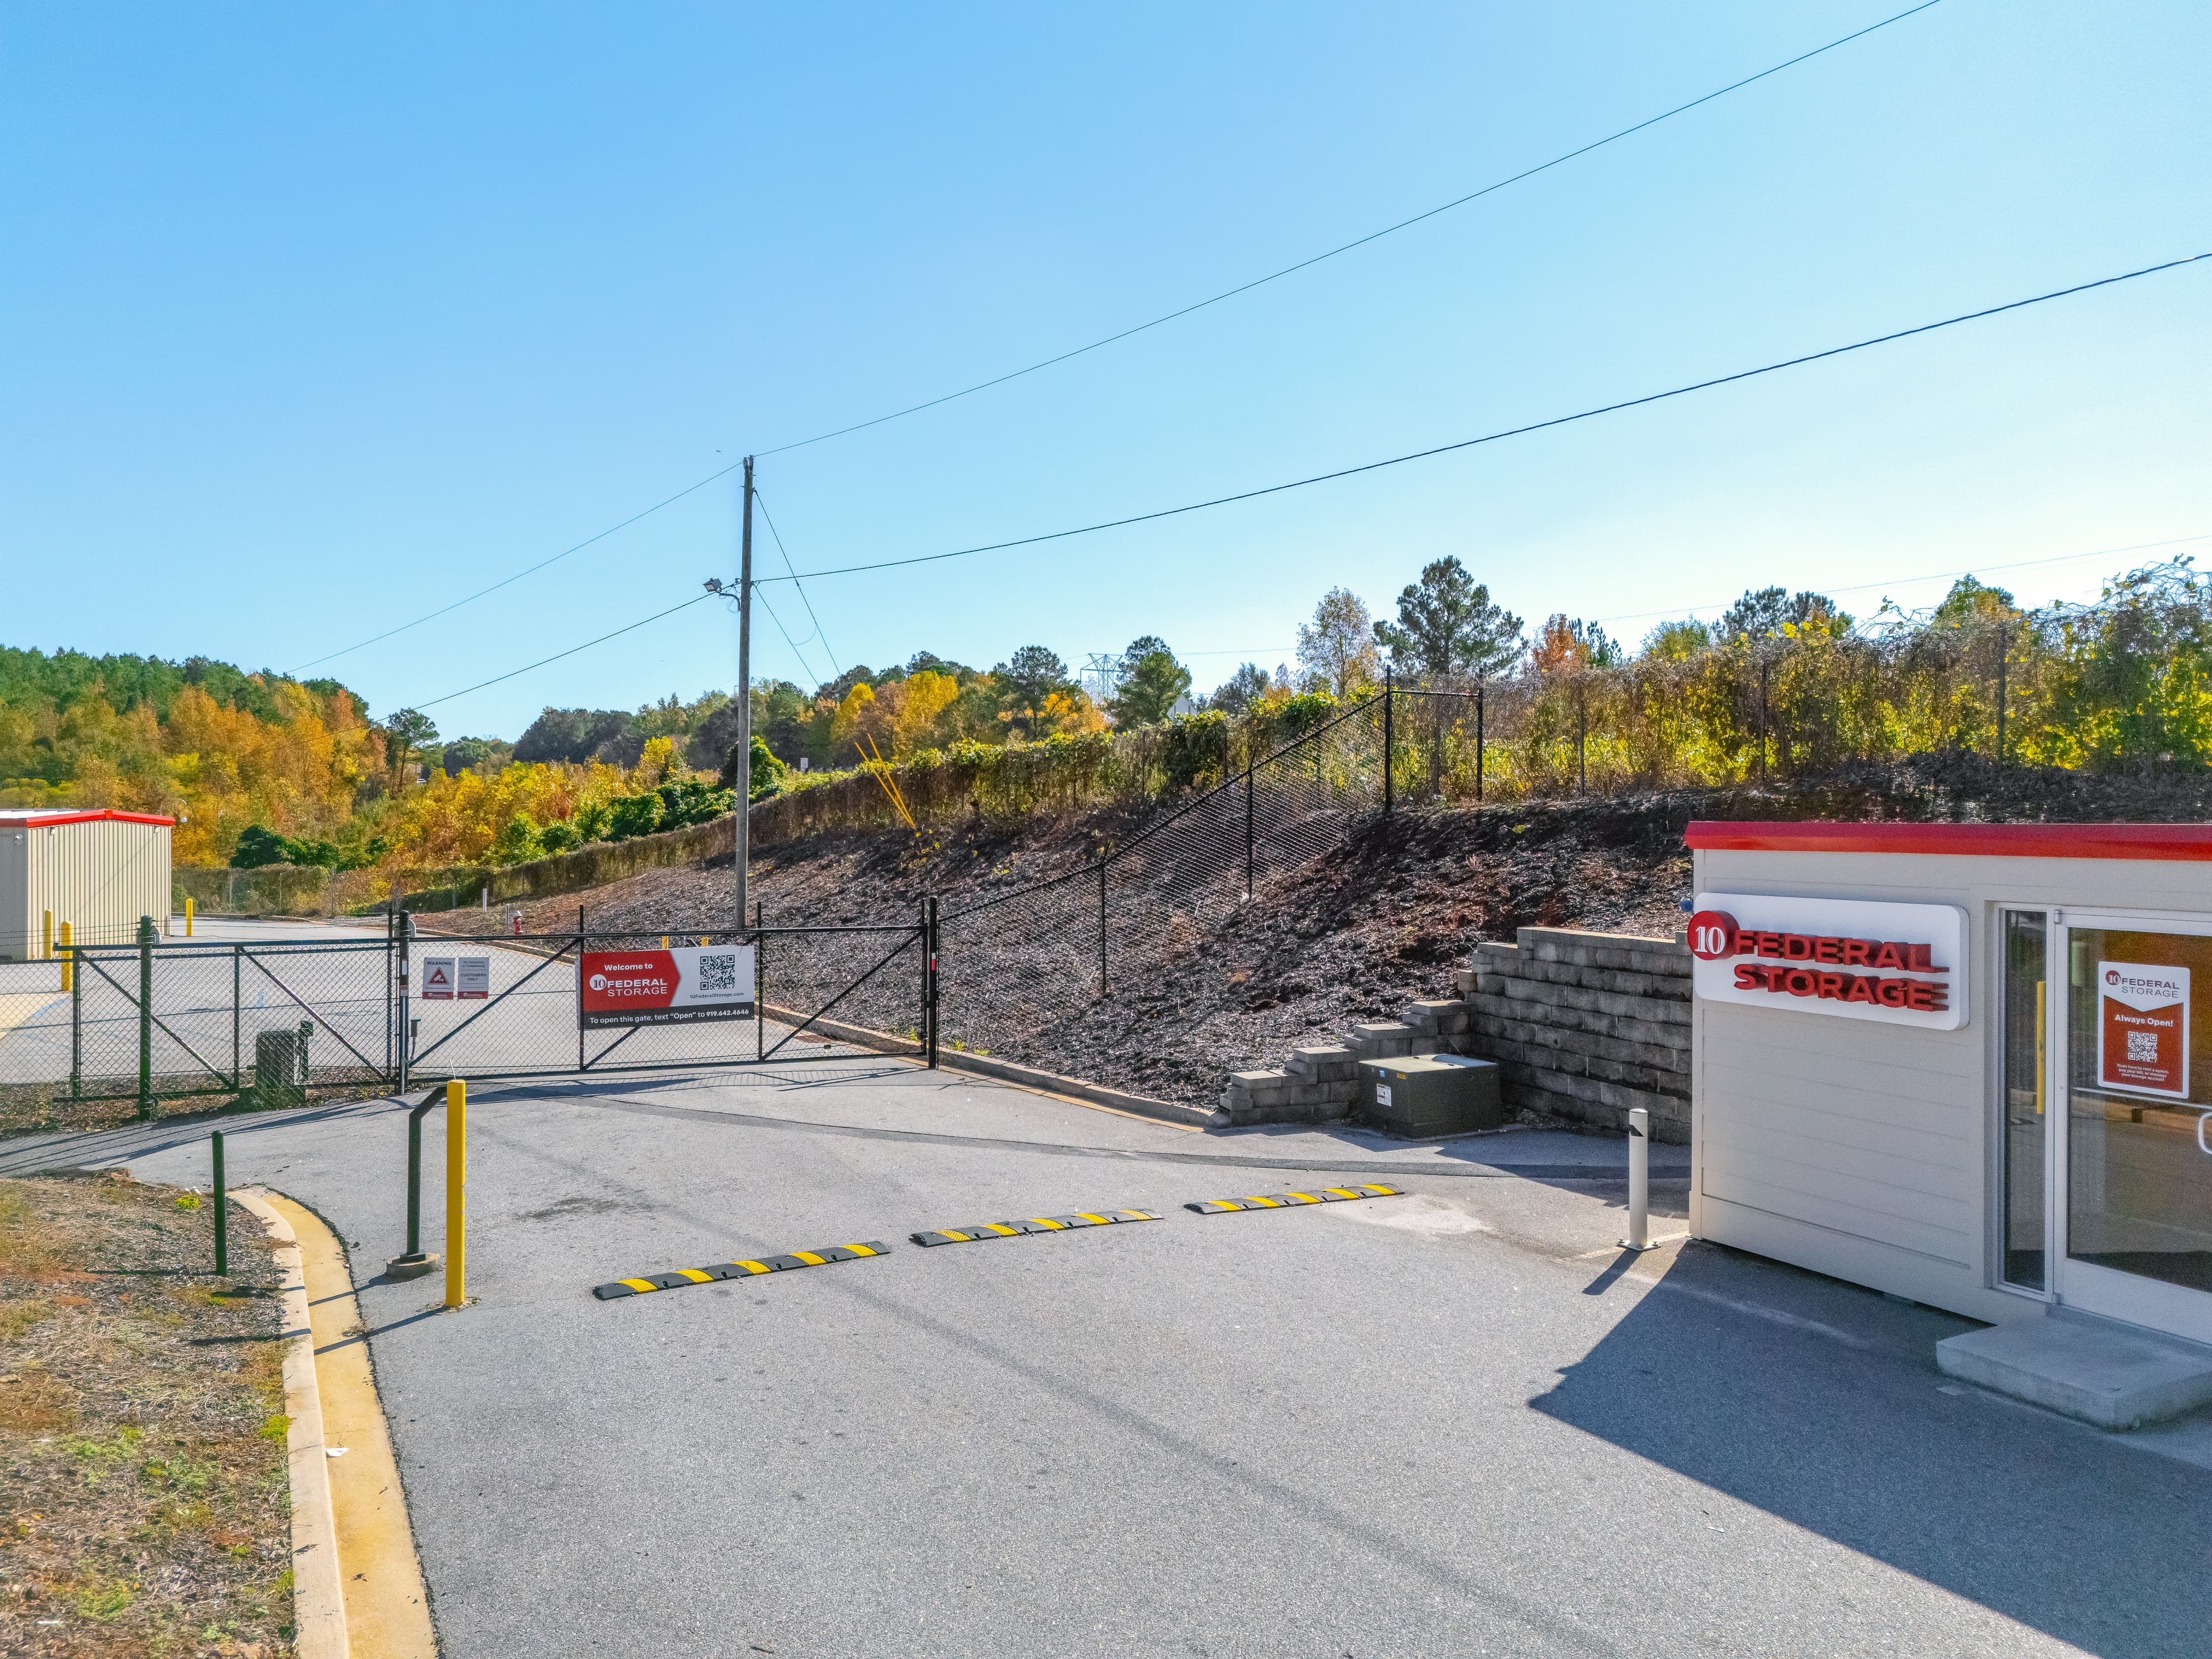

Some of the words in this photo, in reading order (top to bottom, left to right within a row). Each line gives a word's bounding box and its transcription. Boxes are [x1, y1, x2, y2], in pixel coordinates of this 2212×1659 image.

[1694, 926, 1725, 955] 10
[1734, 930, 1949, 974] FEDERAL
[593, 979, 605, 988] 10
[607, 978, 668, 988] FEDERAL
[1734, 963, 1949, 1012] STORAGE
[2108, 975, 2120, 984] 10
[2122, 978, 2180, 990] FEDERAL
[608, 986, 668, 997] STORAGE
[2122, 986, 2179, 998] STORAGE
[2115, 1014, 2145, 1025] Always
[2147, 1018, 2173, 1027] Open!
